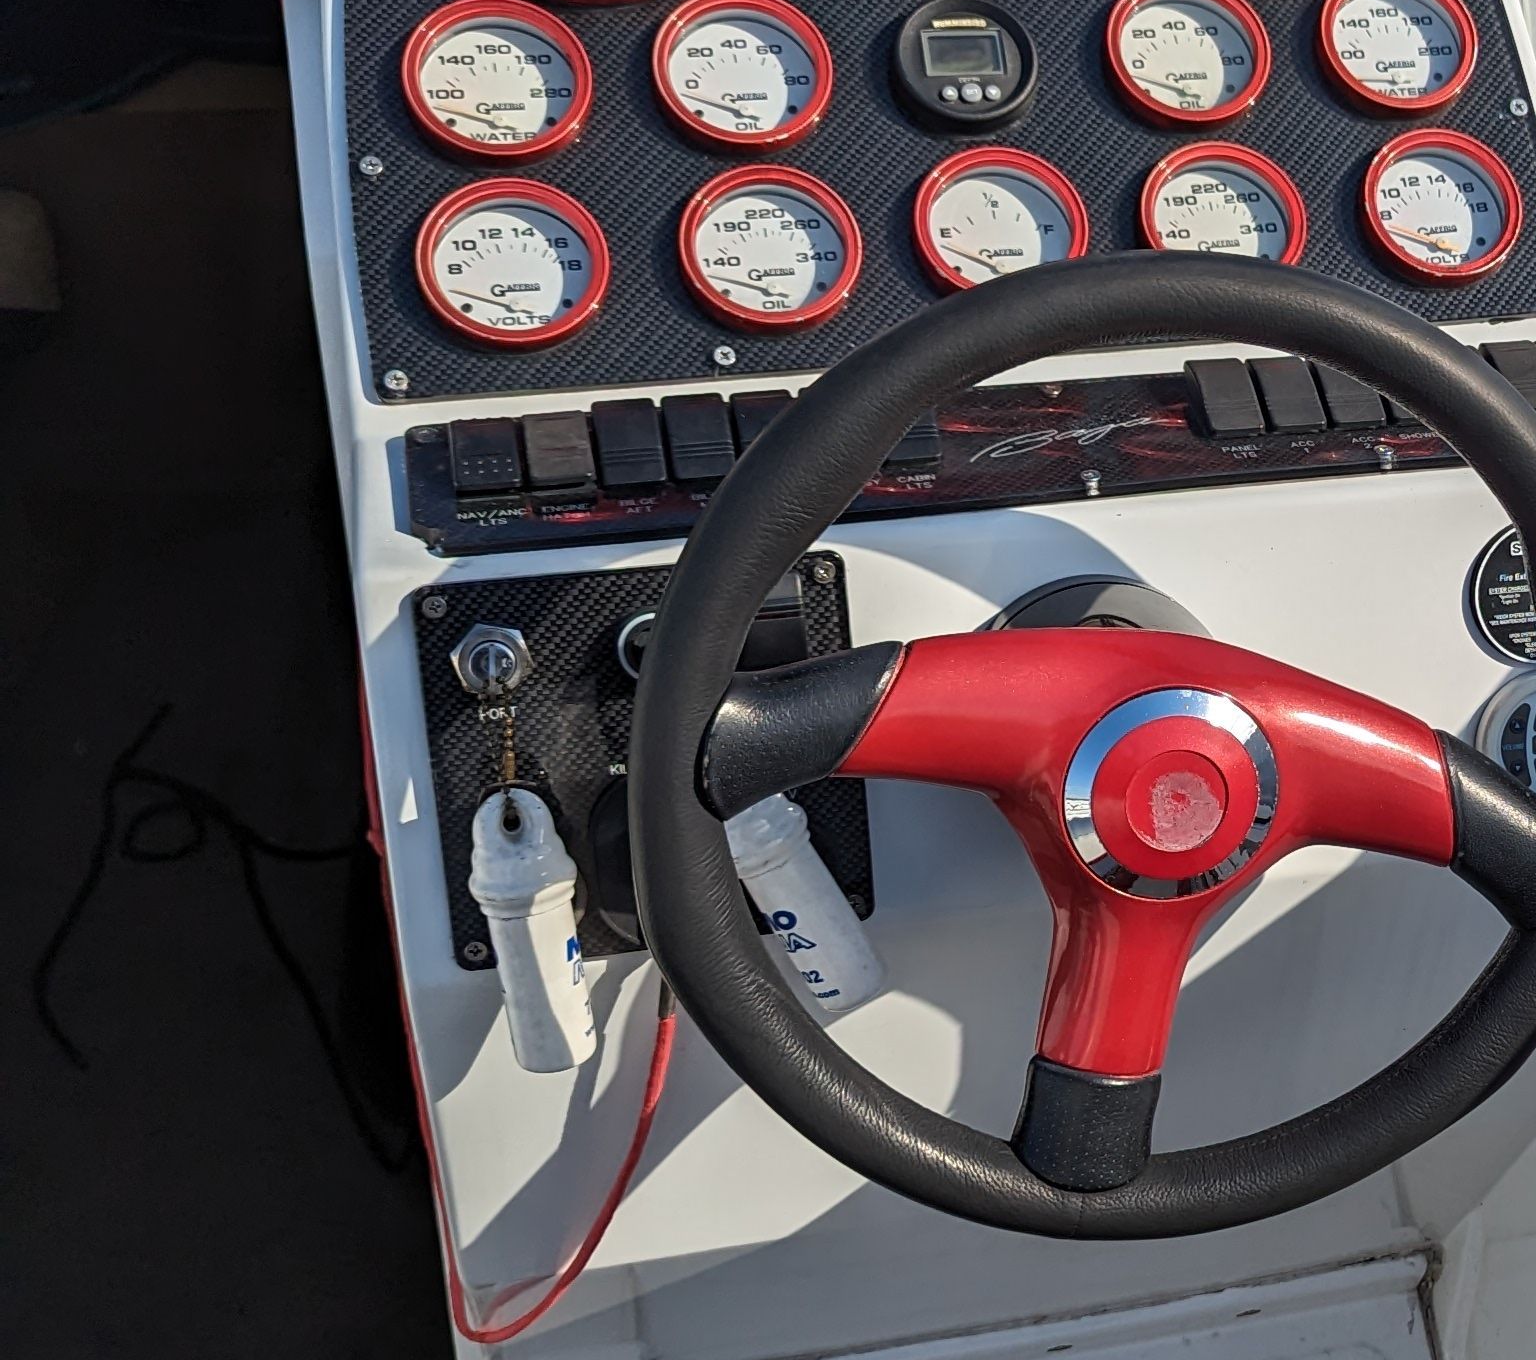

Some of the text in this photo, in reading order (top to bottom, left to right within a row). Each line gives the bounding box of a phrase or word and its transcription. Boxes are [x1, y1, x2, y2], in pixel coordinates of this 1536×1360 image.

[1368, 8, 1399, 18] 160
[1162, 21, 1186, 31] 40
[1339, 18, 1370, 30] 140
[1401, 15, 1433, 26] 190
[1132, 29, 1156, 39] 20
[1194, 26, 1219, 37] 60
[720, 39, 748, 49] 40
[756, 44, 783, 55] 60
[475, 45, 512, 55] 160
[687, 47, 714, 58] 20
[438, 55, 475, 66] 140
[515, 54, 552, 65] 190
[1132, 59, 1145, 70] 0
[1222, 56, 1245, 66] 80
[685, 79, 699, 90] 0
[784, 75, 810, 86] 80
[427, 89, 465, 100] 100
[530, 88, 572, 99] 280
[1179, 101, 1206, 110] OIL
[735, 122, 764, 131] OIL
[470, 132, 538, 142] WATER
[1400, 177, 1421, 187] 12
[1426, 174, 1447, 185] 14
[1190, 183, 1228, 194] 220
[1455, 182, 1475, 193] 16
[1224, 192, 1260, 205] 260
[1381, 188, 1401, 199] 10
[1163, 195, 1198, 207] 190
[1469, 202, 1489, 213] 18
[745, 209, 786, 220] 220
[1380, 210, 1393, 221] 8
[713, 221, 751, 232] 190
[780, 219, 821, 231] 260
[1043, 225, 1054, 235] F
[1239, 223, 1278, 235] 340
[478, 228, 503, 240] 12
[511, 227, 536, 238] 14
[940, 227, 952, 239] E
[452, 240, 478, 251] 10
[545, 237, 569, 249] 16
[703, 256, 741, 268] 140
[796, 251, 837, 263] 340
[448, 263, 463, 275] 8
[558, 260, 583, 271] 18
[762, 300, 791, 310] OIL
[488, 315, 552, 327] VOLTS
[1290, 439, 1316, 449] ACC
[1351, 435, 1377, 445] ACC
[1221, 444, 1261, 454] PANEL
[1363, 442, 1372, 450] 2
[1232, 451, 1258, 460] LTS
[895, 473, 937, 484] CABIN
[906, 481, 934, 490] LTS
[456, 507, 527, 521] NAV/ANC
[479, 517, 508, 528] LTS
[1499, 574, 1514, 582] Fire
